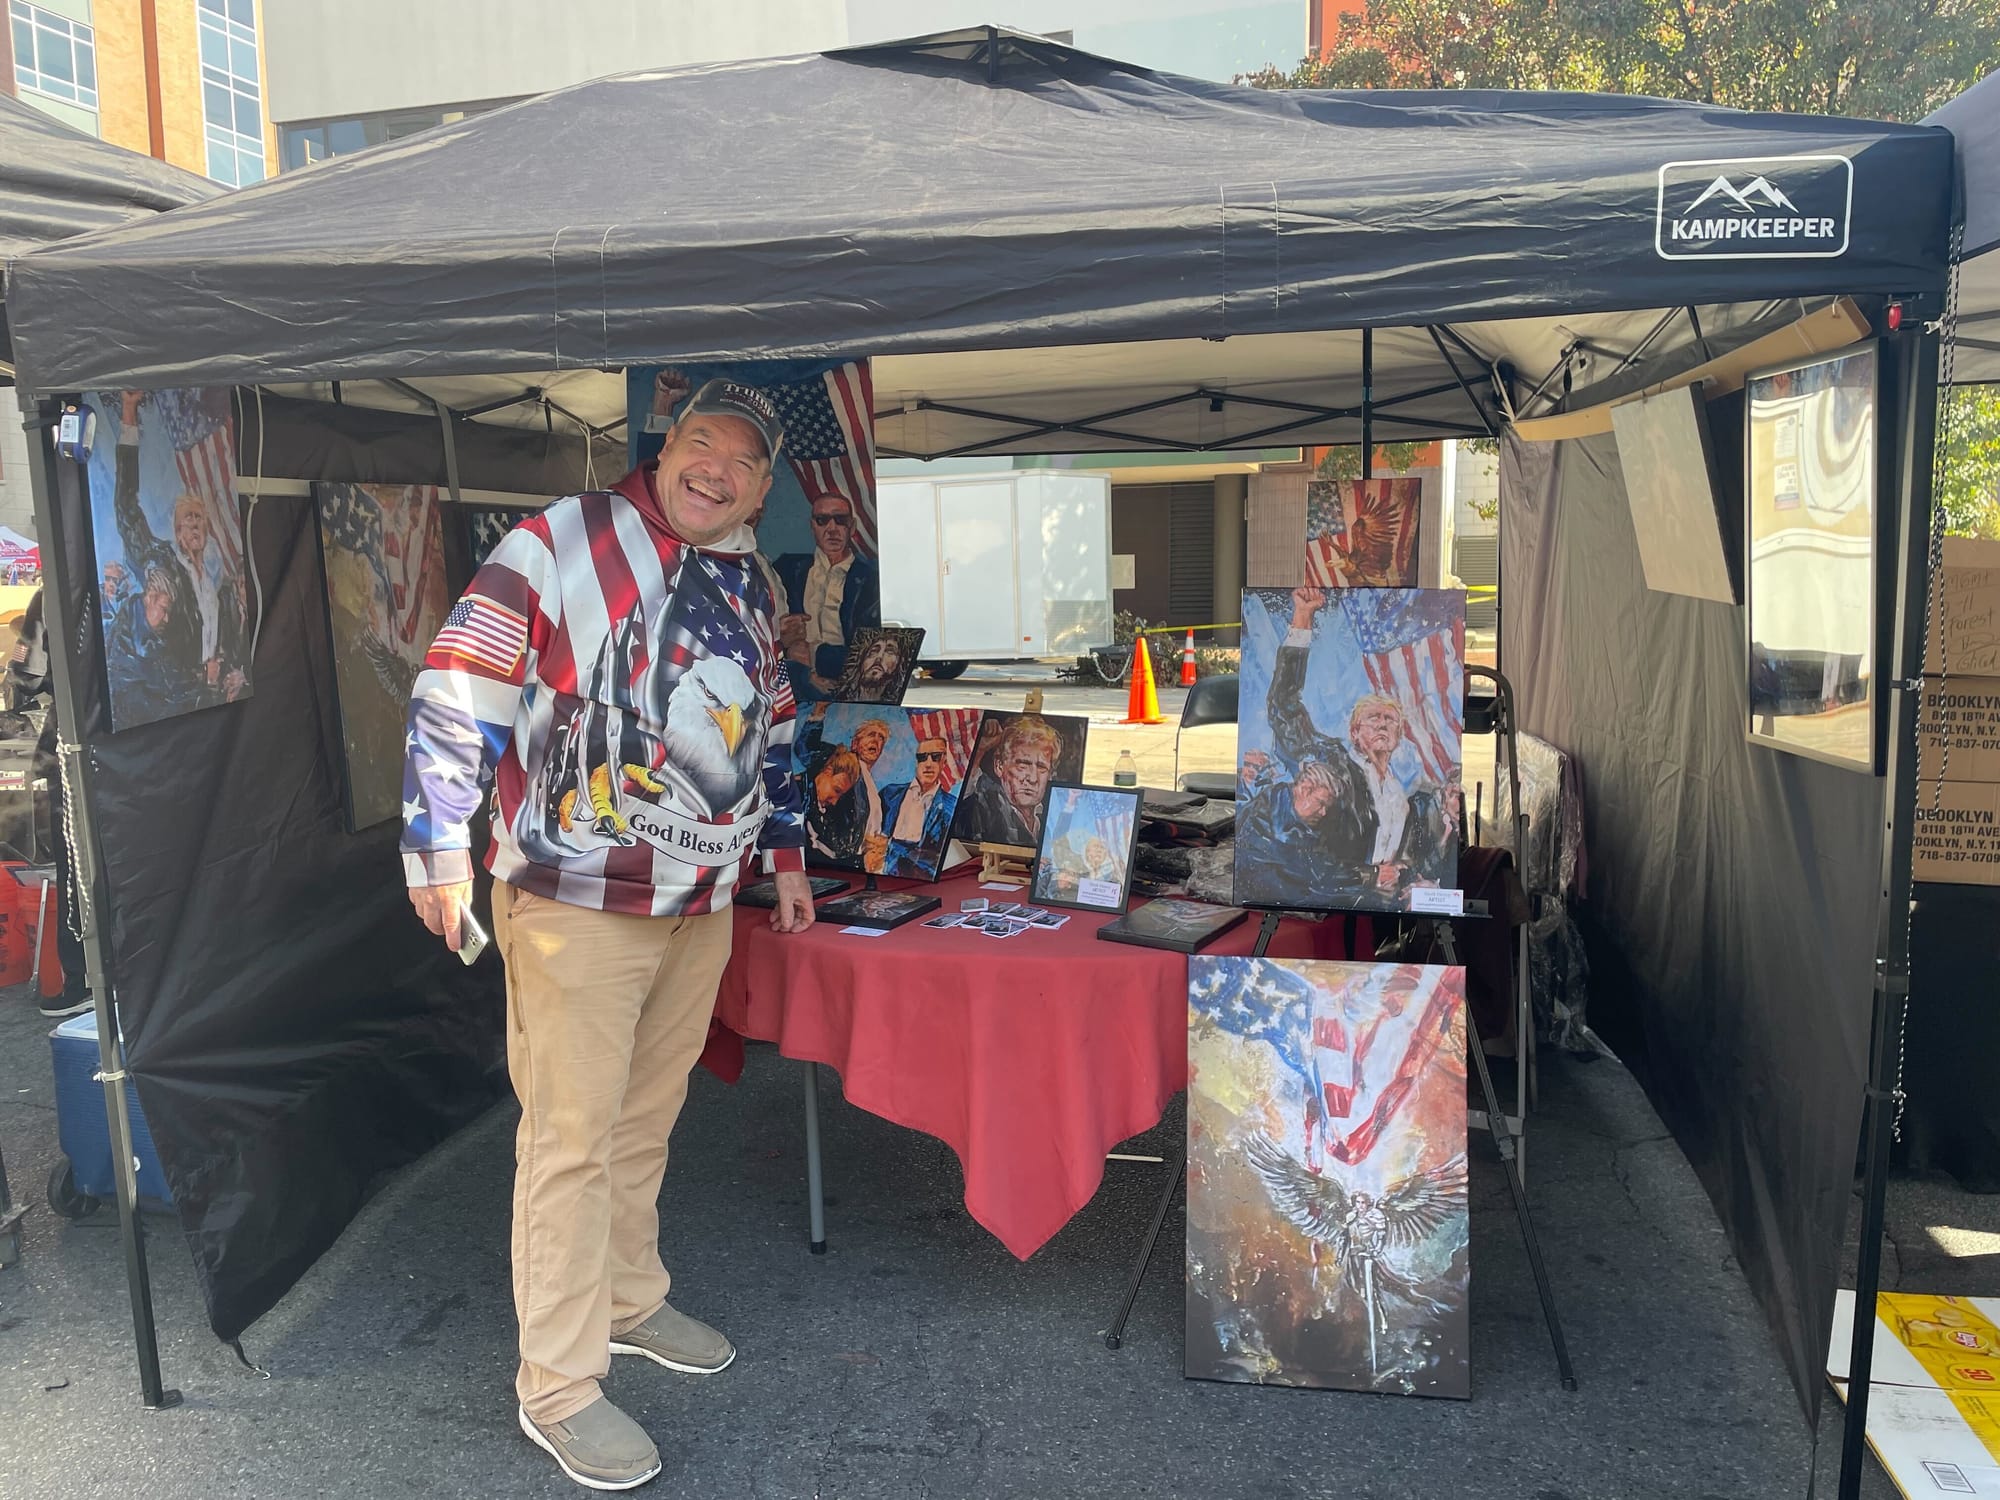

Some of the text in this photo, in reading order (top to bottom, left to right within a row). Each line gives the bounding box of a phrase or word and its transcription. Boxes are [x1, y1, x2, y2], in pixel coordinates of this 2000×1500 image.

[1671, 217, 1835, 240] KAMPKEEPER
[1962, 711, 1985, 722] 18TH
[1976, 726, 1997, 736] N.Y.
[630, 813, 769, 855] God Bless Aerica
[1921, 824, 1946, 834] 8118
[1951, 825, 1975, 836] 18TH
[1915, 837, 1962, 850] OOKLYN,
[1966, 839, 1987, 849] N.Y.
[1919, 850, 2000, 863] 718-837-0709
